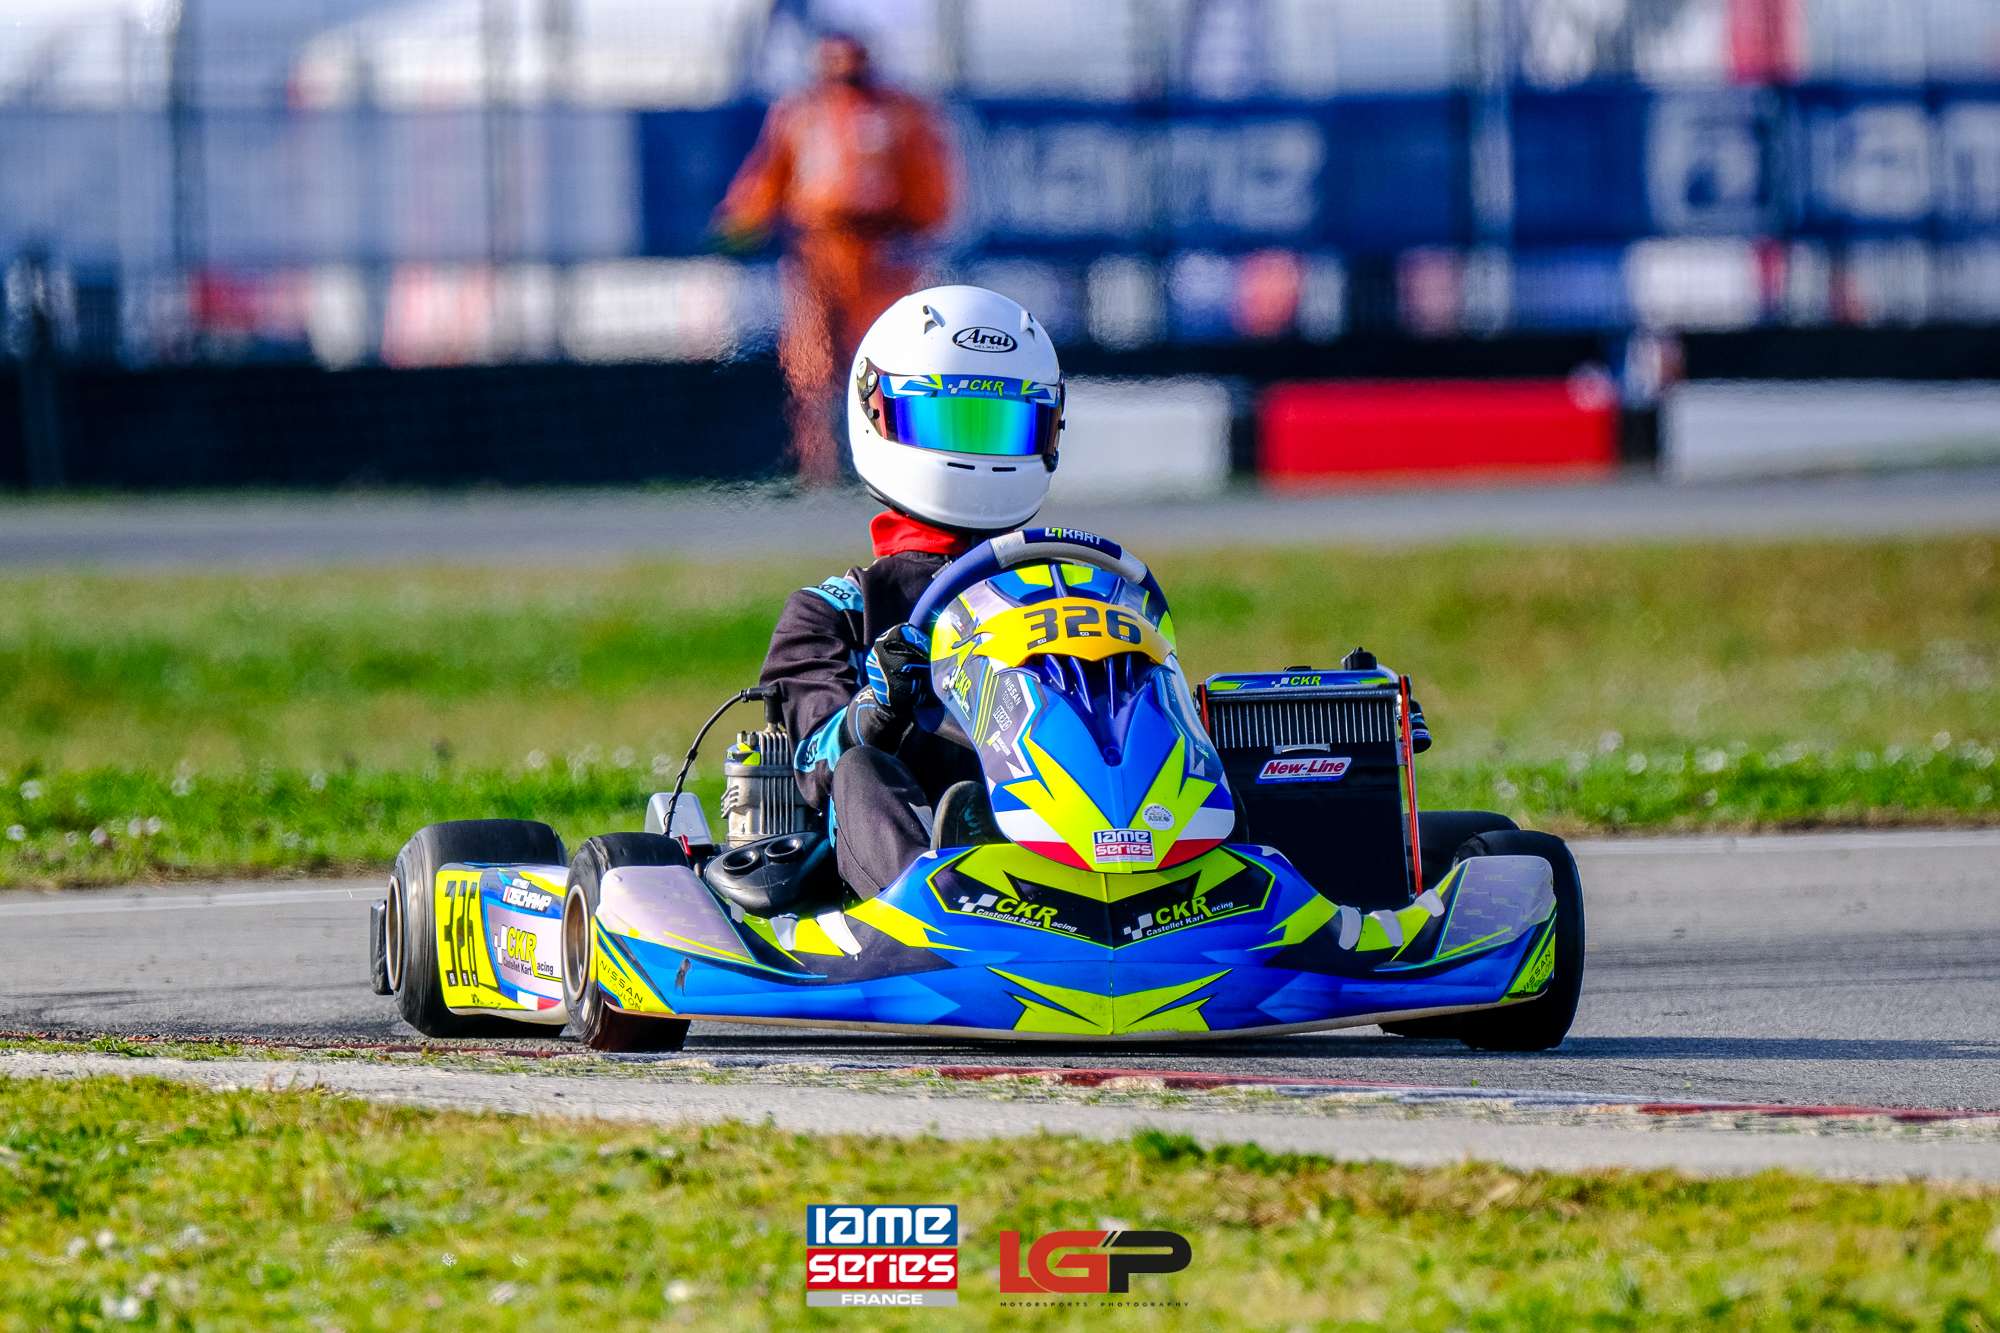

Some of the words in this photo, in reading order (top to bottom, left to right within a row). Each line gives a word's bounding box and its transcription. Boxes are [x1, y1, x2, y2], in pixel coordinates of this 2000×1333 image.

[958, 329, 1010, 347] Arai
[969, 380, 1004, 396] CKR
[1024, 606, 1141, 650] 326
[1290, 676, 1321, 687] CKR
[1264, 760, 1345, 774] New-Line
[1096, 844, 1152, 856] series
[976, 908, 1019, 922] Castellet
[1019, 917, 1041, 927] Kart
[995, 898, 1058, 929] CKR
[1155, 896, 1213, 925] CKR
[1146, 918, 1183, 936] Castellet
[1185, 914, 1204, 924] Kart
[507, 926, 538, 976] CKR
[600, 960, 643, 1004] NISSAN
